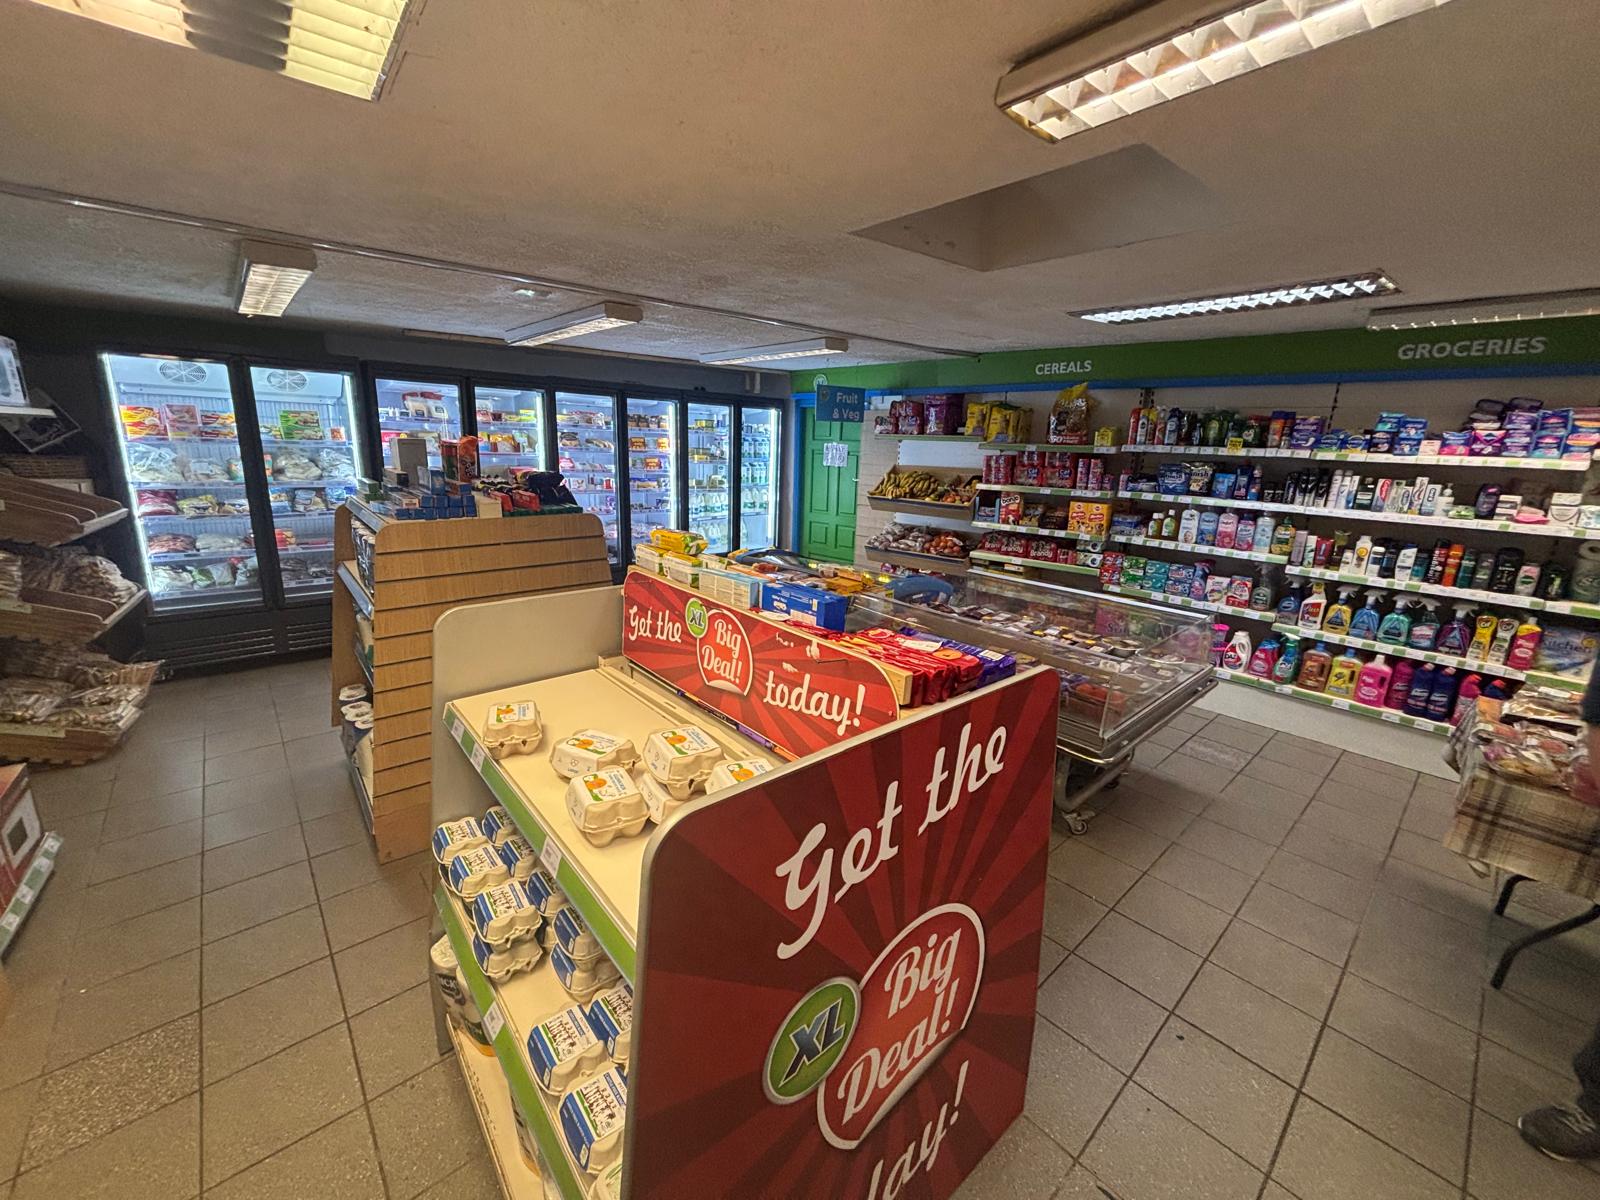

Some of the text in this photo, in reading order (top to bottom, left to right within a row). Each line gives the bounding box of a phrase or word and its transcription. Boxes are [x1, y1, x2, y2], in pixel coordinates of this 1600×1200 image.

[1035, 360, 1092, 375] CEREALS
[1398, 337, 1547, 360] GROCERIES
[832, 408, 860, 420] & Veg
[836, 392, 858, 404] Fruit
[1001, 545, 1023, 553] Brandy
[1030, 549, 1053, 558] Brandy
[628, 605, 682, 643] Get the
[689, 607, 705, 629] XL
[714, 619, 742, 660] Big
[702, 644, 743, 685] Deal!
[764, 670, 866, 736] today!
[776, 722, 1008, 960] Get the
[884, 927, 962, 1020] Big
[778, 996, 846, 1089] XL
[837, 977, 960, 1127] Deal!
